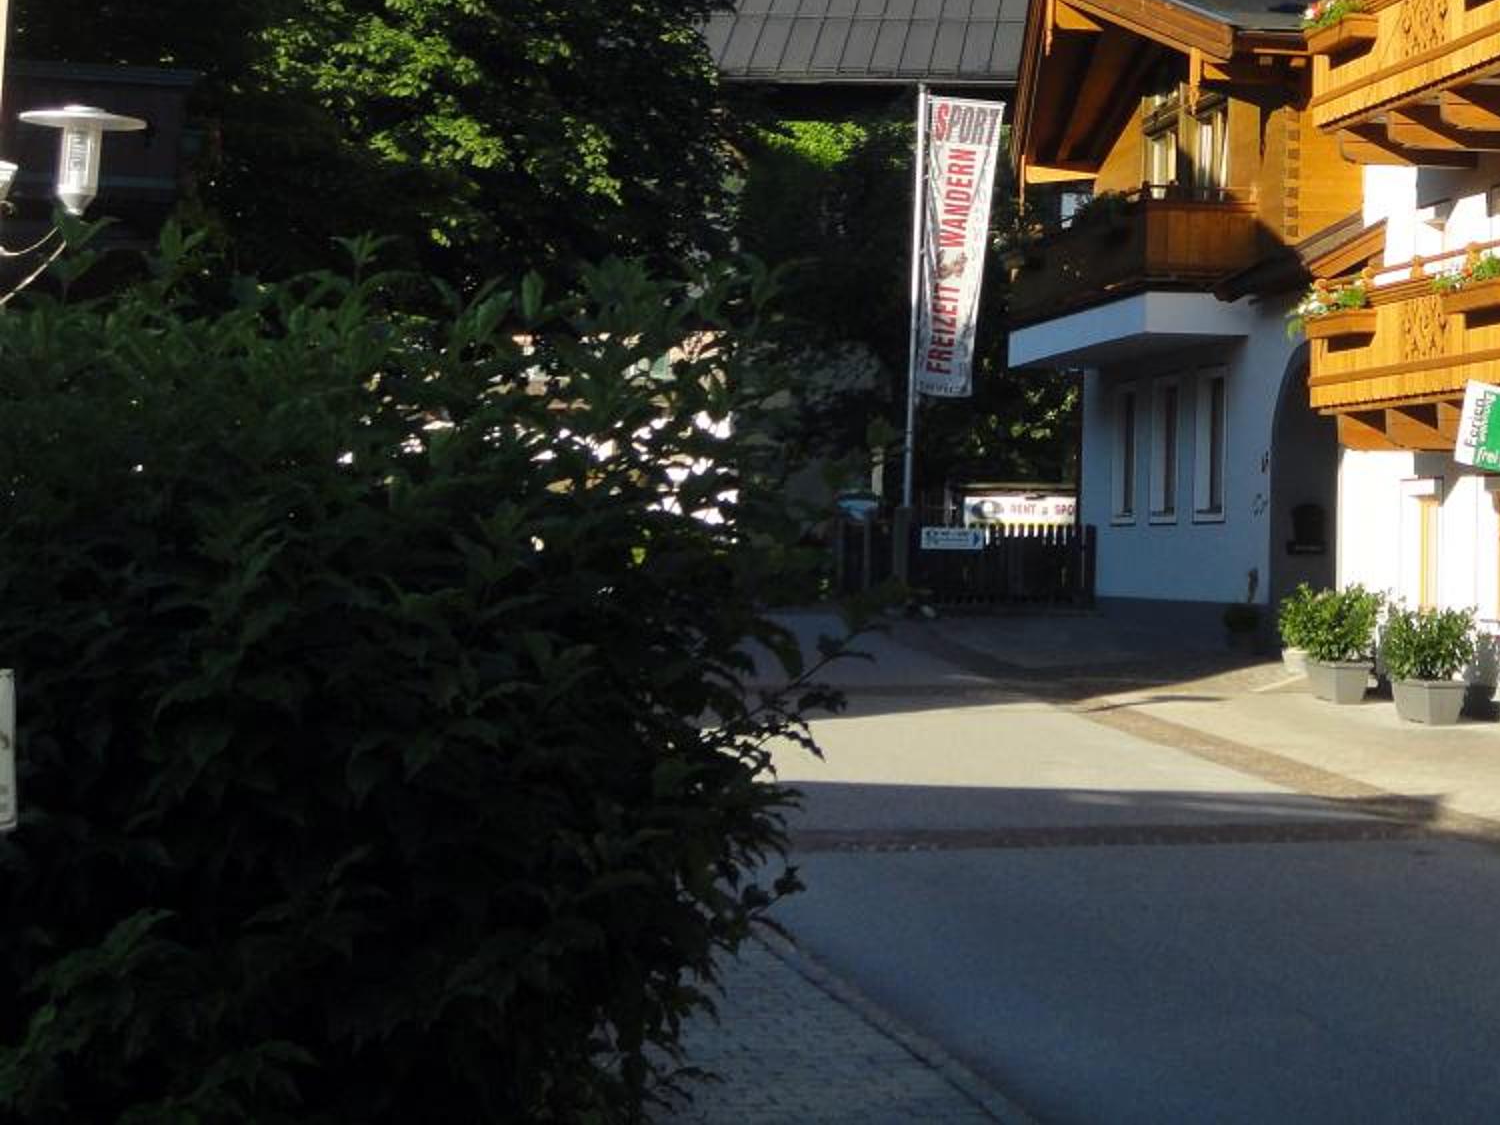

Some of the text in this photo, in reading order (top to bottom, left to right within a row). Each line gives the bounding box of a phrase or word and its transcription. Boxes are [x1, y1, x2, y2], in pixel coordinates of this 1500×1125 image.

[934, 102, 1000, 147] SPORT
[938, 148, 977, 249] WANDERN
[926, 283, 961, 375] FREIZEIT
